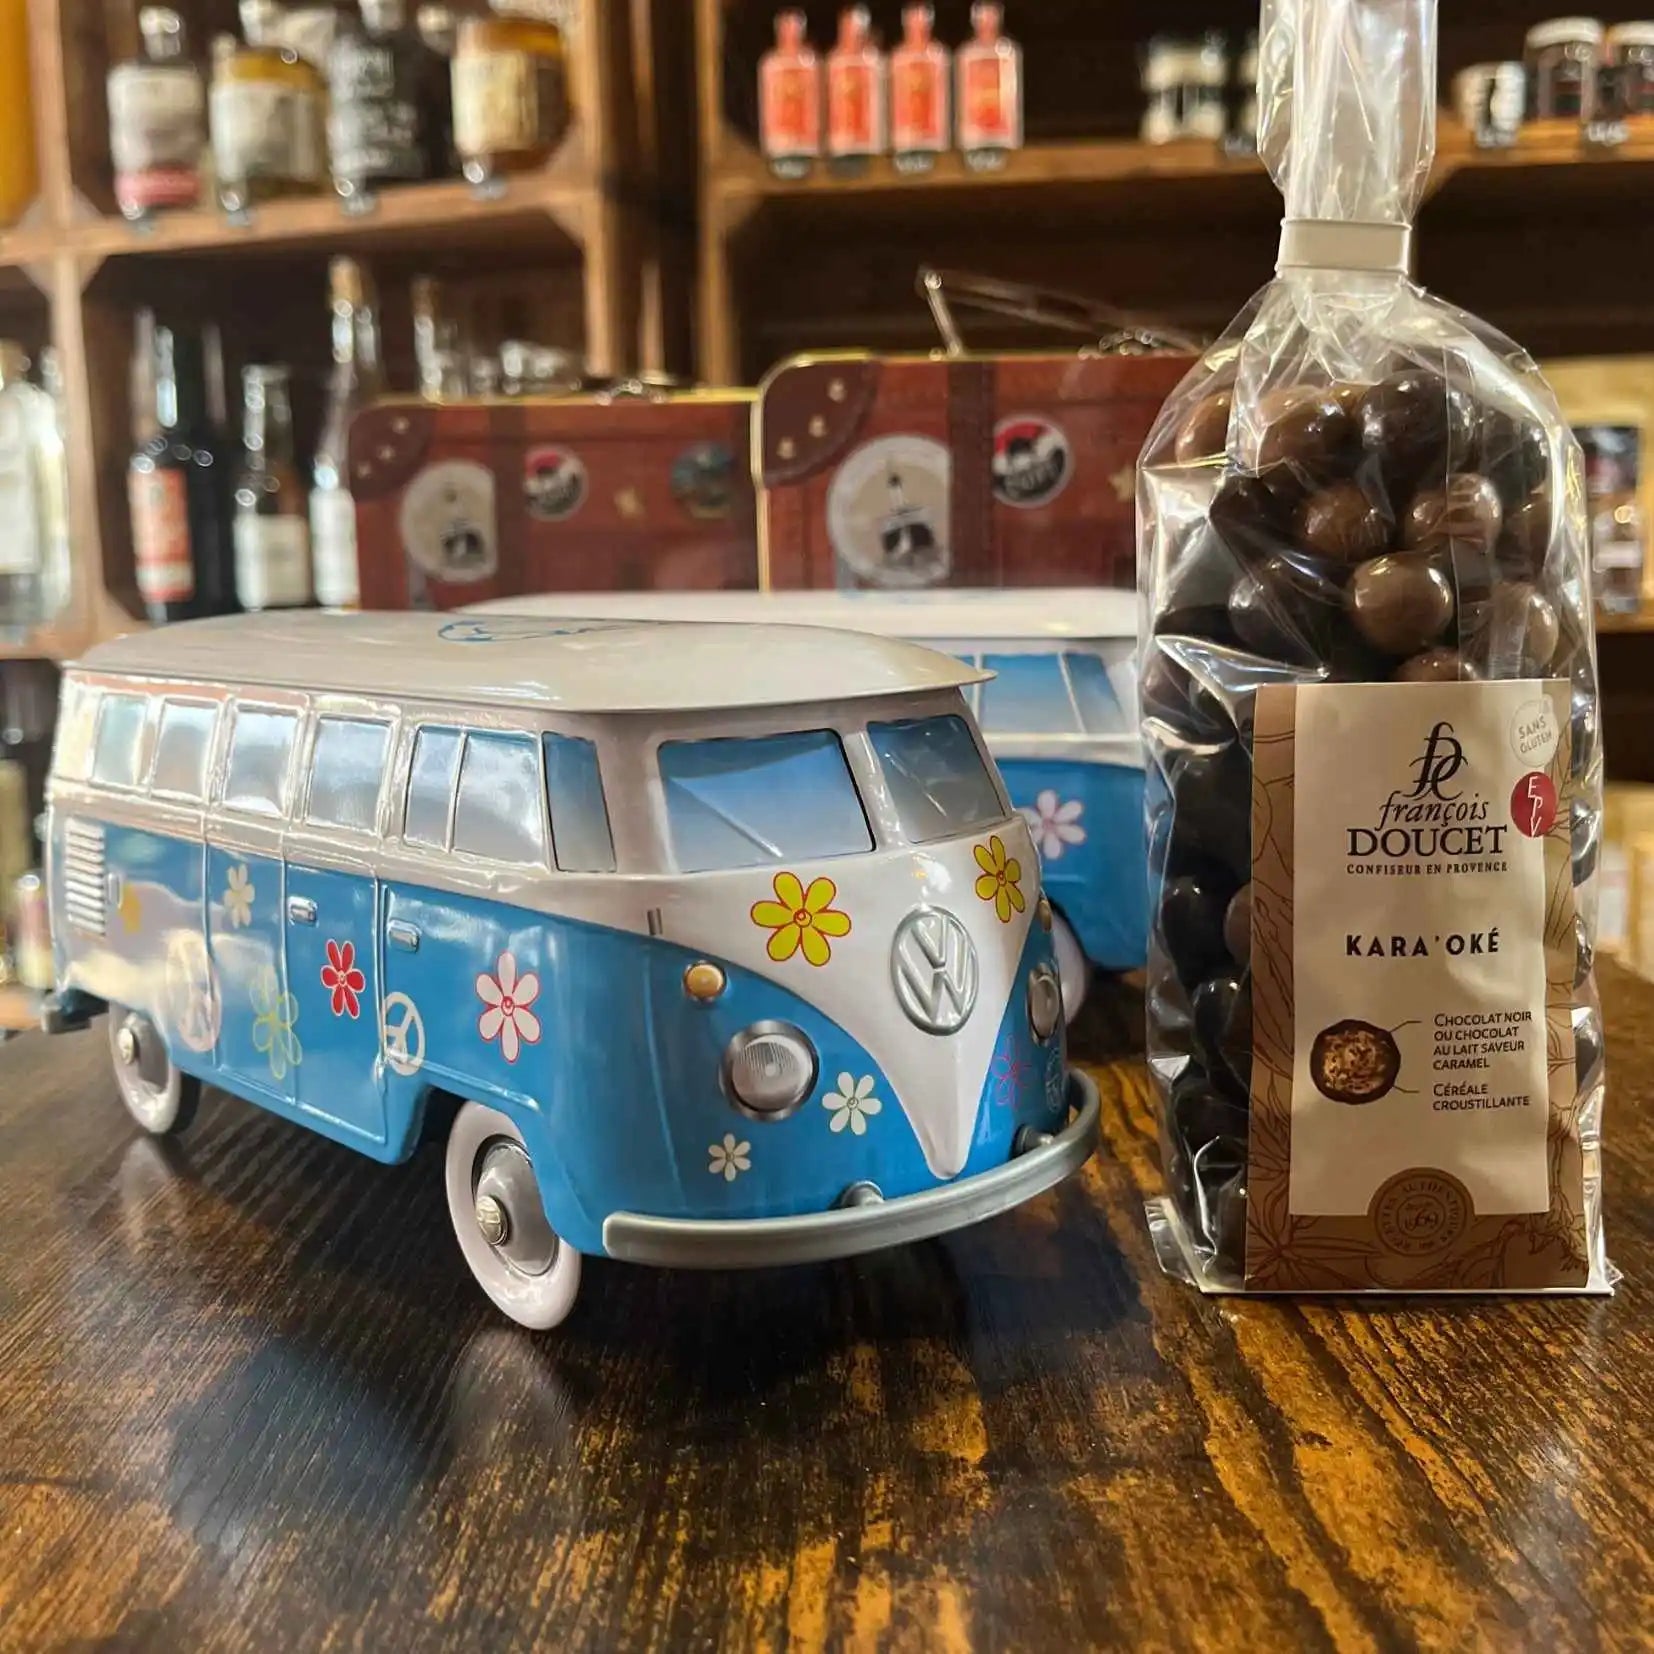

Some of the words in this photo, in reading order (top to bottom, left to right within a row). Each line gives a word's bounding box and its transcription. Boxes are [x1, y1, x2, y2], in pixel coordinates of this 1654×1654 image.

[1518, 714, 1547, 740] SANS
[1374, 790, 1489, 831] françois
[1346, 824, 1508, 857] DOUCET
[1346, 864, 1421, 875] CONFISEUR
[1426, 863, 1442, 874] EN
[1446, 861, 1508, 874] PROVENCE
[1346, 927, 1500, 957] KARA'OKÉ
[1503, 1011, 1532, 1023] NOIR
[1434, 1030, 1452, 1041] OU
[1455, 1026, 1519, 1041] CHOCOLAT
[1433, 1045, 1450, 1056] AU
[1453, 1044, 1479, 1055] LAIT
[1481, 1040, 1525, 1053] SAVEUR
[1432, 1057, 1490, 1071] CARAMEL
[1432, 1096, 1530, 1111] CROUSTILLANTE
